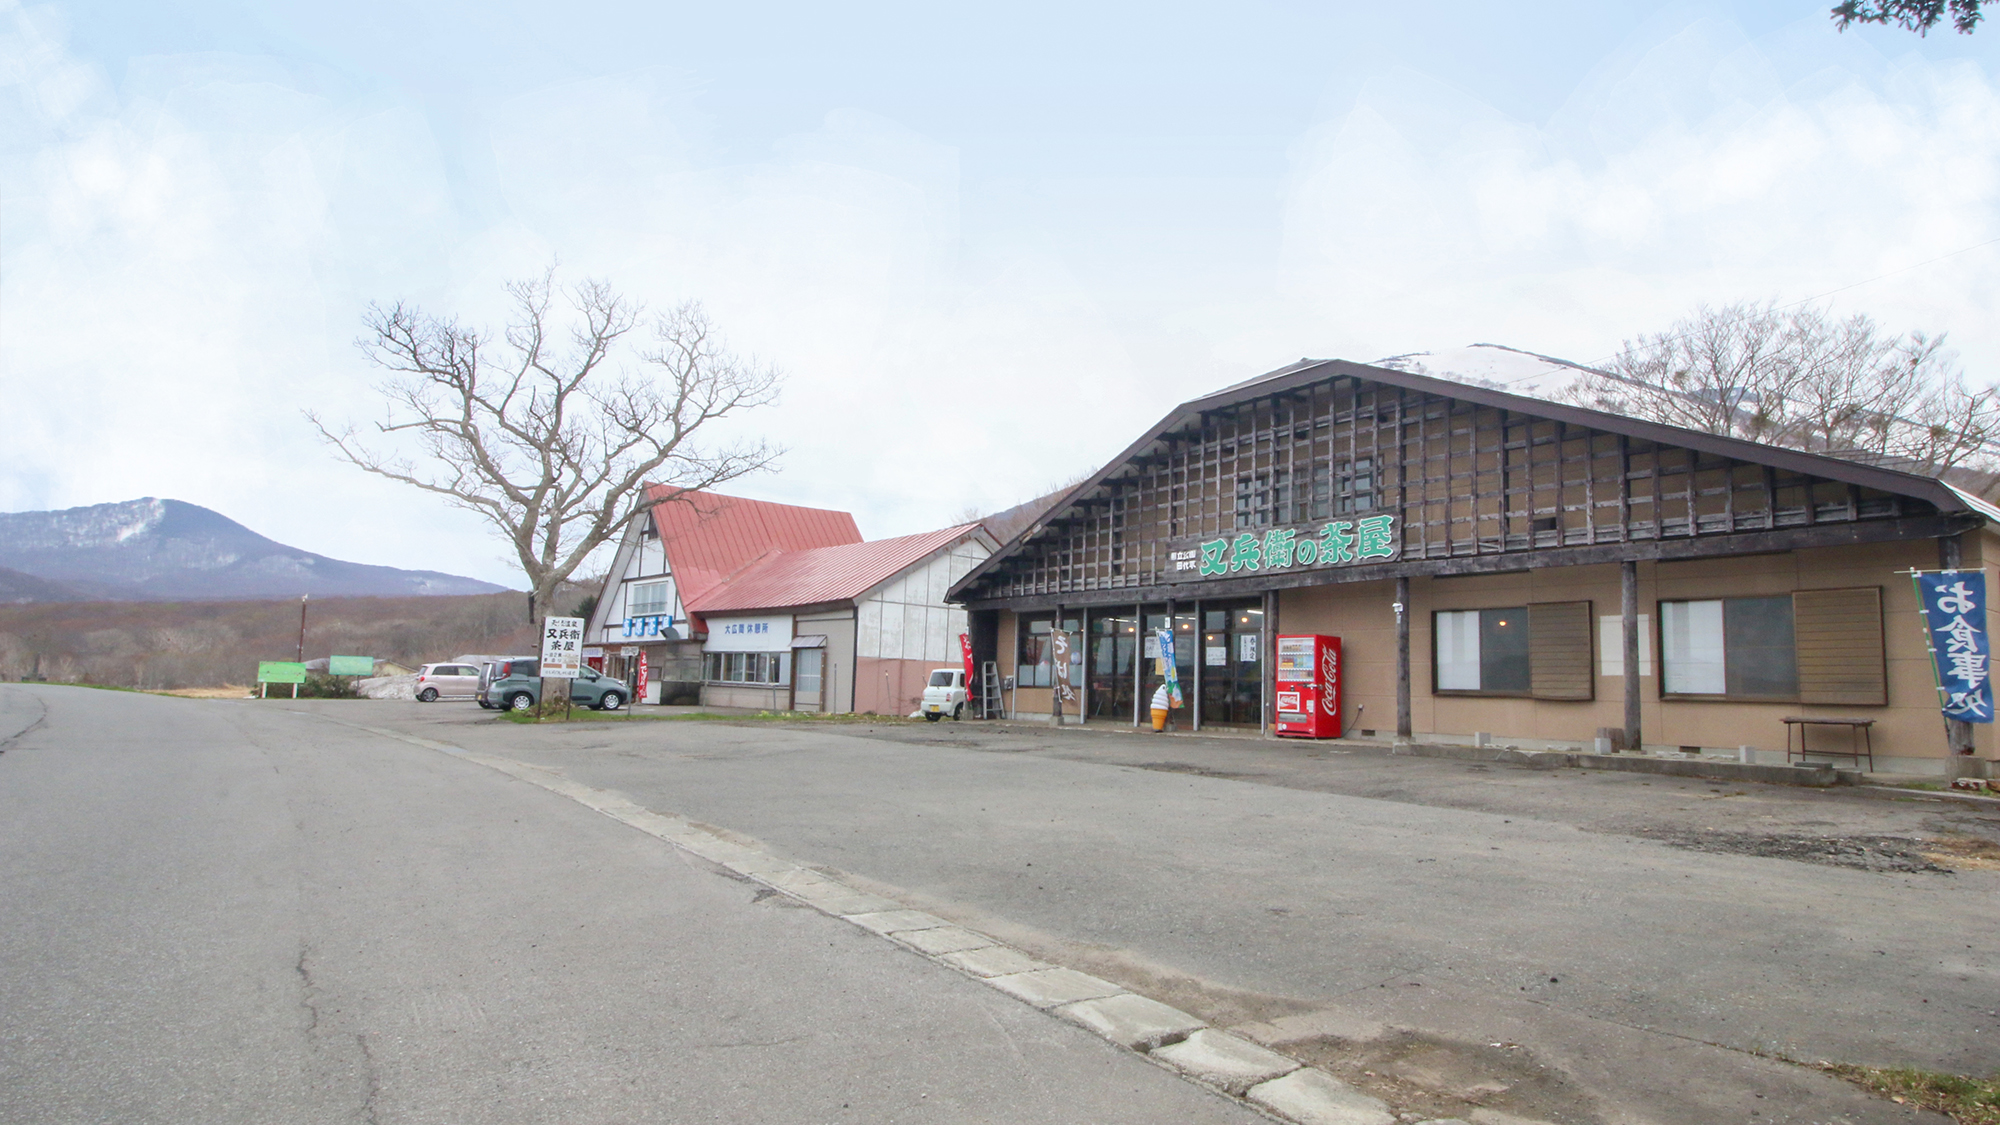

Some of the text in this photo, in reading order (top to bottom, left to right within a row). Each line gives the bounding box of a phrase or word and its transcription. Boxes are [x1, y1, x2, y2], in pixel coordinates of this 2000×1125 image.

[1200, 515, 1395, 576] 又兵衛の茶屋
[1176, 560, 1197, 571] 田代平
[546, 628, 581, 640] 又兵衛
[550, 640, 575, 651] 茶屋
[1321, 643, 1337, 716] Coca-Cola
